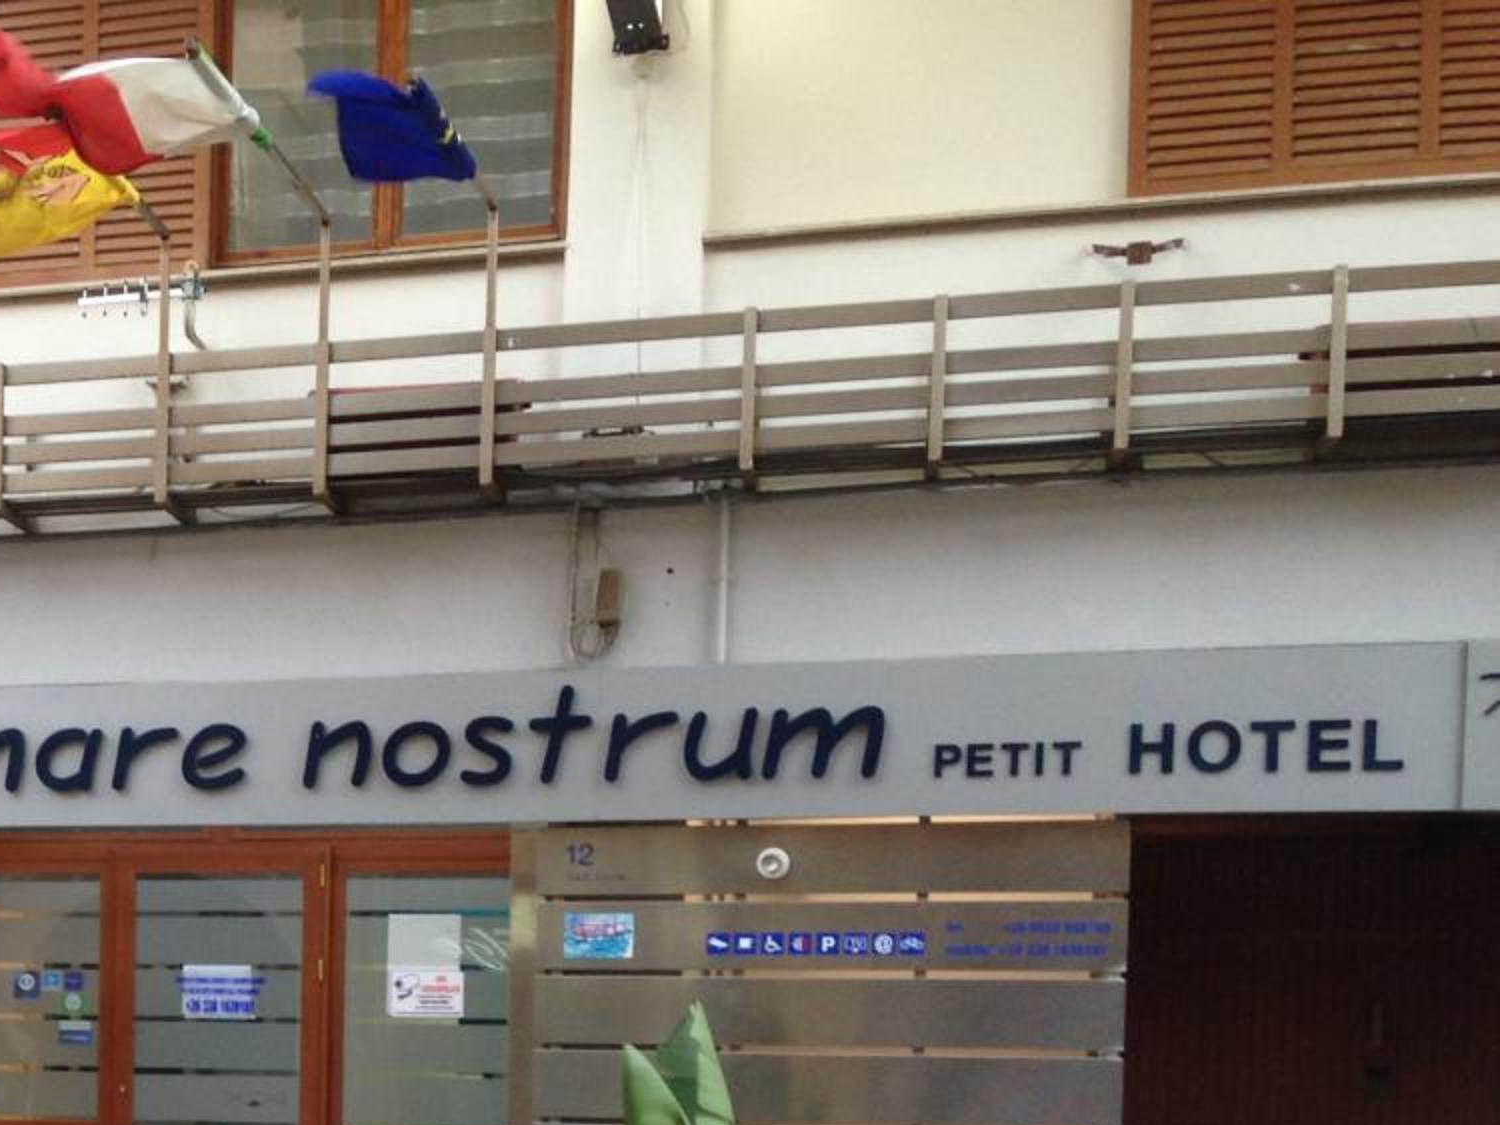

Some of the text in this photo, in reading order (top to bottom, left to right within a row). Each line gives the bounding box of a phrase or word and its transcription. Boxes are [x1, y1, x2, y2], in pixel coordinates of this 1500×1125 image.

[302, 685, 886, 791] nostrum
[933, 741, 1083, 778] PETIT
[1127, 719, 1404, 775] HOTEL
[565, 841, 595, 866] 12
